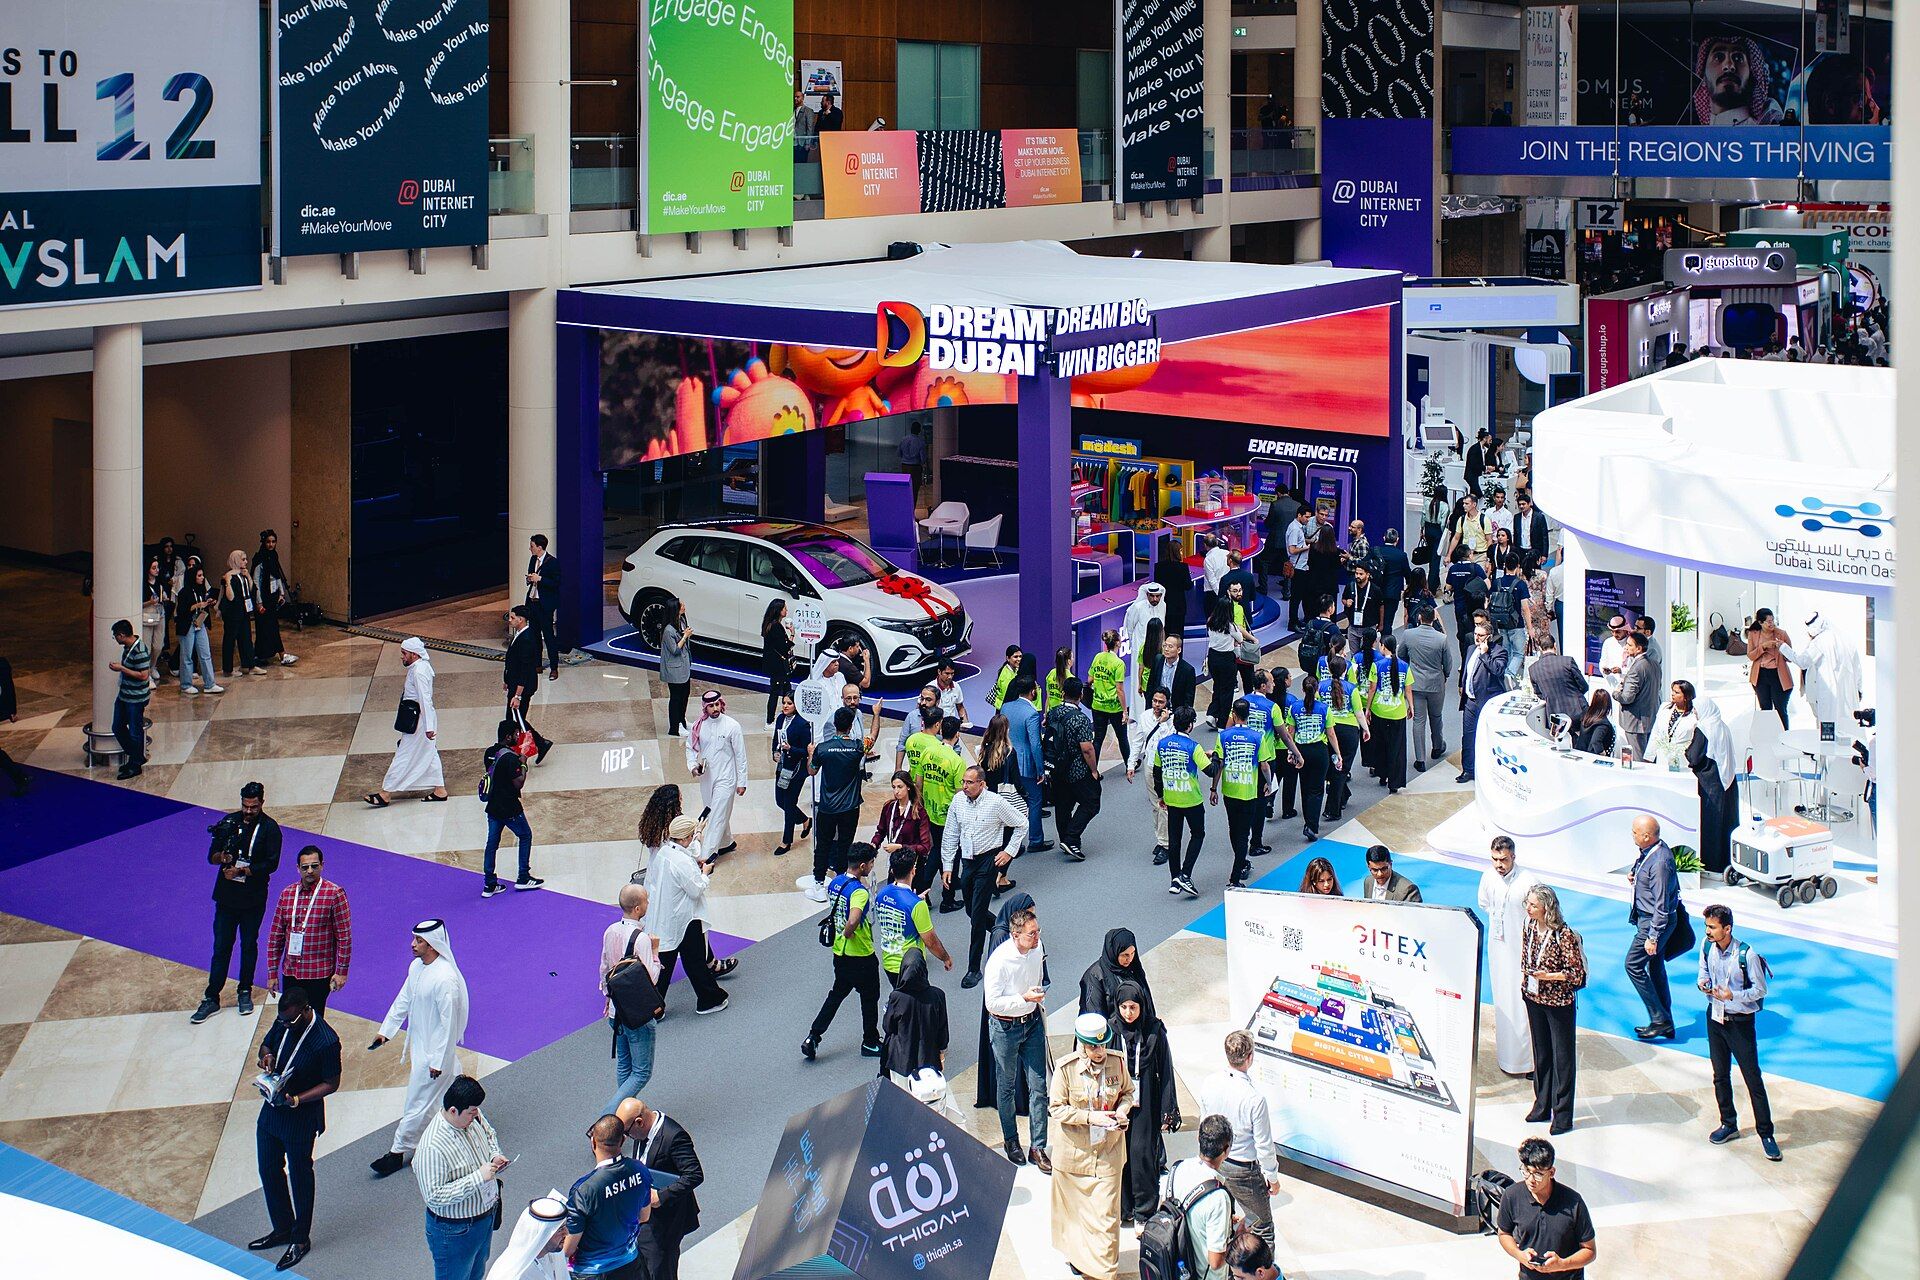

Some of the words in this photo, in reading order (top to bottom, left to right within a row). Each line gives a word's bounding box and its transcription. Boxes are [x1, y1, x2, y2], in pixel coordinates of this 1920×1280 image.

[281, 4, 309, 29] Your
[651, 0, 736, 27] Engage
[1122, 0, 1137, 25] Make
[1326, 5, 1336, 20] Your
[1400, 8, 1410, 25] Your
[382, 28, 418, 43] Make
[416, 10, 445, 34] Your
[1126, 16, 1145, 43] Make
[1128, 36, 1152, 62] Make
[1150, 17, 1172, 39] Your
[1169, 0, 1197, 23] Move
[1391, 25, 1402, 41] Your
[304, 52, 333, 77] Your
[332, 15, 356, 56] Move
[1372, 38, 1382, 55] Your
[1527, 33, 1553, 43] AFRICA
[38, 49, 78, 77] TO
[423, 50, 446, 89] Make
[443, 28, 469, 52] Your
[1128, 57, 1158, 83] Make
[1158, 39, 1183, 60] Your
[1364, 54, 1375, 71] Your
[1126, 77, 1163, 105] Make
[1164, 58, 1199, 82] Your
[1345, 68, 1356, 84] Your
[1420, 73, 1431, 90] Your
[312, 93, 337, 135] Make
[334, 71, 362, 97] Your
[362, 62, 399, 78] Move
[430, 91, 465, 106] Make
[464, 71, 489, 96] Your
[1337, 84, 1348, 101] Your
[1394, 78, 1412, 92] Make
[1411, 90, 1422, 107] Your
[1123, 98, 1168, 128] Make
[1170, 80, 1204, 103] Your
[96, 72, 216, 161] 12
[320, 134, 358, 152] Make
[356, 115, 386, 141] Your
[383, 80, 405, 120] Move
[719, 110, 795, 151] Engage
[1036, 136, 1048, 145] TIME
[1049, 136, 1056, 145] TO
[1122, 119, 1171, 149] Make
[1014, 158, 1023, 167] SET
[1024, 158, 1031, 166] UP
[1032, 157, 1046, 166] YOUR
[1047, 156, 1070, 166] BUSINESS
[1017, 147, 1033, 156] MAKE
[1034, 147, 1048, 155] YOUR
[1176, 156, 1191, 165] DUBAI
[1520, 140, 1568, 162] JOIN
[1576, 141, 1619, 162] THE
[1628, 141, 1743, 163] REGION'S
[1751, 142, 1875, 163] THRIVING
[845, 153, 860, 175] @
[861, 152, 885, 165] DUBAI
[862, 167, 898, 180] INTERNET
[1021, 169, 1036, 177] DUBAI
[1037, 168, 1059, 176] INTERNET
[1060, 167, 1071, 176] CITY
[1176, 167, 1198, 176] INTERNET
[730, 171, 745, 191] @
[747, 170, 771, 182] DUBAI
[1130, 171, 1145, 180] dic.ae
[1130, 181, 1166, 191] #MakeYourMove
[1176, 178, 1188, 188] CITY
[398, 180, 419, 205] @
[423, 178, 456, 193] DUBAI
[662, 191, 687, 202] dic.ae
[747, 184, 784, 196] INTERNET
[863, 183, 881, 196] CITY
[1333, 180, 1356, 203] @
[1360, 180, 1398, 194] DUBAI
[300, 204, 336, 218] dic.ae
[423, 195, 475, 211] INTERNET
[662, 204, 726, 216] #MakeYourMove
[747, 200, 765, 212] CITY
[1360, 197, 1422, 211] INTERNET
[423, 214, 448, 229] CITY
[1360, 214, 1388, 227] CITY
[1587, 204, 1615, 225] 12
[300, 219, 392, 235] #MakeYourMove
[1773, 241, 1790, 250] data
[1706, 255, 1758, 269] gupshup
[929, 303, 1046, 341] DREAM
[1055, 302, 1117, 336] DREAM
[929, 337, 1036, 376] DUBAI
[1057, 348, 1096, 378] WIN
[1096, 337, 1162, 372] BIGGER!
[1247, 438, 1338, 461] EXPERIENCE
[1338, 447, 1360, 464] IT!
[1774, 552, 1813, 570] Dubai
[1817, 558, 1867, 577] Silicon
[1226, 763, 1253, 773] ZERO
[1244, 920, 1264, 931] GITEX
[1249, 928, 1265, 938] PLUS
[1352, 924, 1427, 960] GITEX
[1358, 947, 1428, 973] GLOBAL
[1313, 1040, 1346, 1056] DIGITAL
[1347, 1050, 1376, 1064] CITIES
[605, 1179, 627, 1199] ASK
[628, 1172, 643, 1188] ME
[869, 1131, 959, 1229] ثقة
[882, 1204, 970, 1252] THIQAH
[925, 1237, 964, 1264] thiqah.sa
